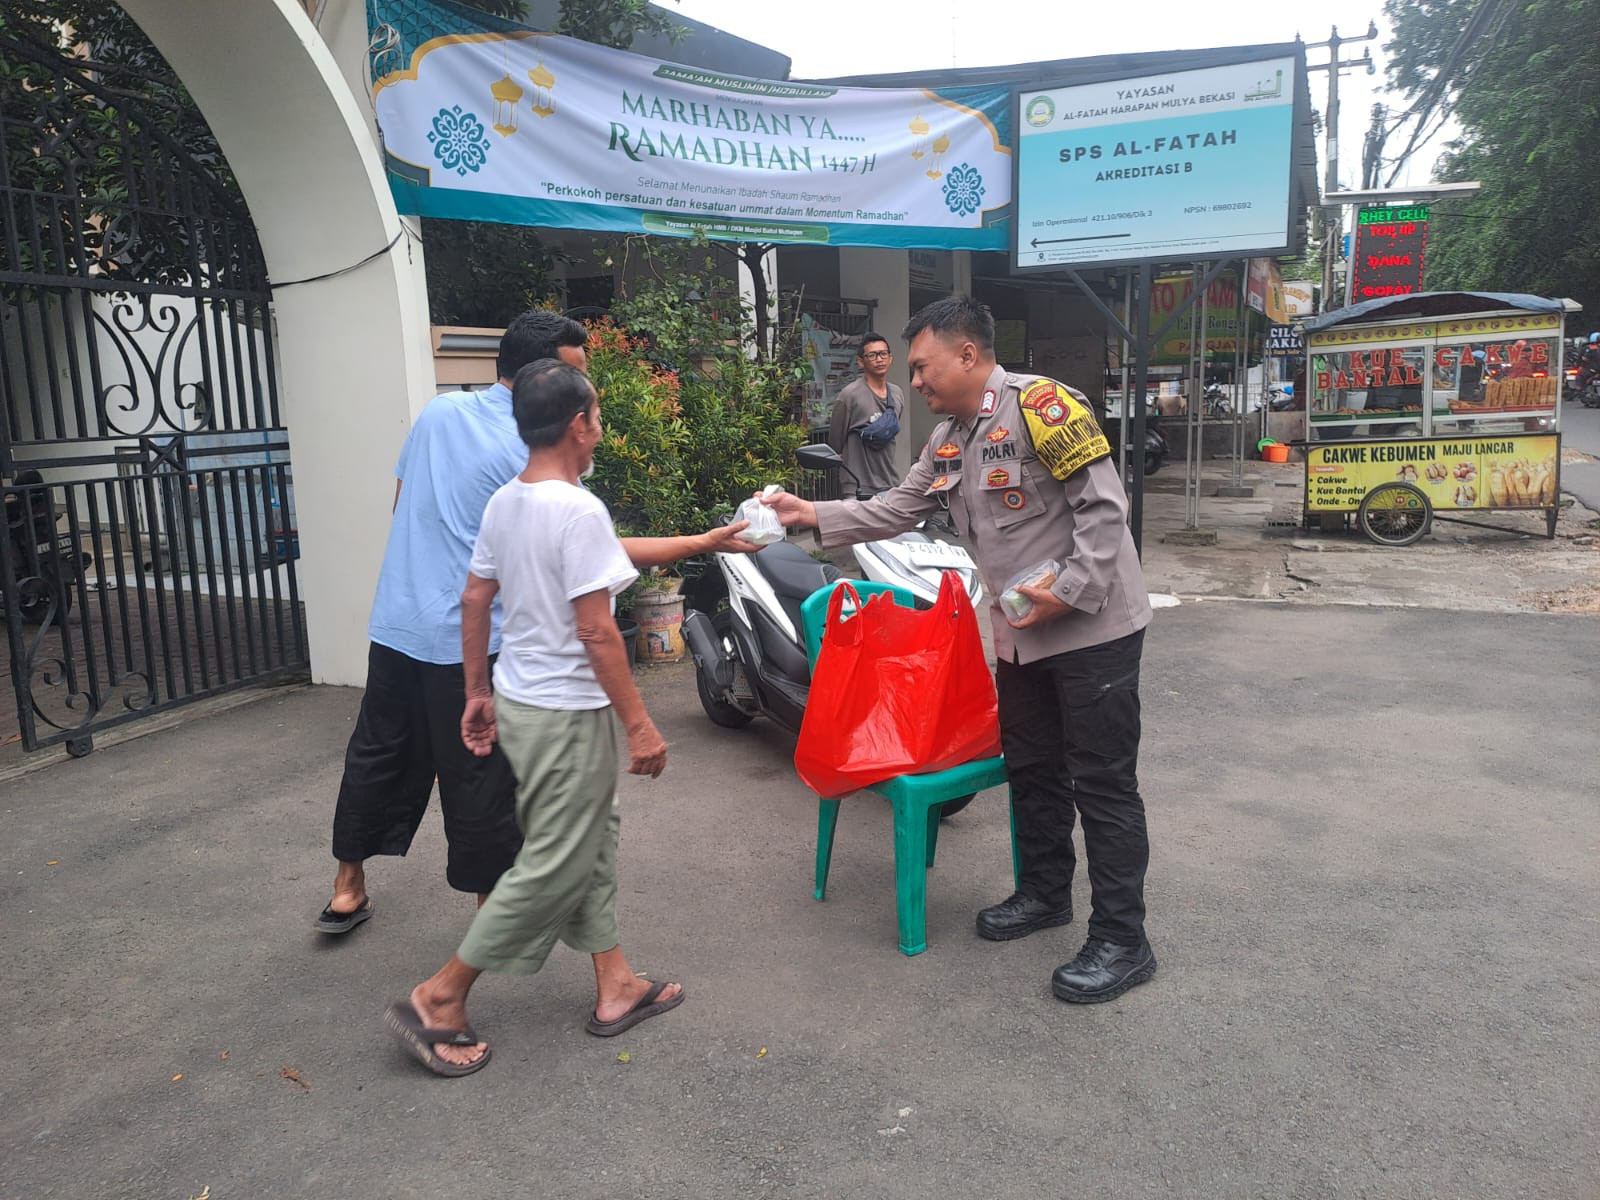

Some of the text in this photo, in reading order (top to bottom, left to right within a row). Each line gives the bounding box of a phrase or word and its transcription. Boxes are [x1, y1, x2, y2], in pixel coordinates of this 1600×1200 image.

[714, 78, 767, 92] MUSLIMIN
[1116, 84, 1176, 101] YAYASAN
[622, 89, 792, 136] MARHABAN
[1063, 91, 1236, 121] AL-FATAH HARAPAN MULYA BEKASI
[608, 121, 877, 175] RAMADHAN 1447 H
[1059, 129, 1238, 163] SPS AL-FATAH
[1095, 161, 1193, 182] AKREDITASI B
[638, 176, 841, 203] Selamat Menunaikan Ibadah Shaum Ramadhan
[605, 191, 663, 207] persatuan
[666, 197, 686, 209] dan
[689, 198, 737, 212] kesatuan
[739, 206, 773, 214] ummat
[775, 207, 803, 217] dalam
[805, 207, 853, 219] Momentum
[1184, 206, 1207, 215] NPSN
[1032, 220, 1045, 228] Izin
[1046, 216, 1088, 227] Operasional
[1370, 226, 1396, 238] TOP
[1367, 256, 1411, 268] DANA
[1361, 285, 1413, 297] GOPAY
[1350, 348, 1405, 369] KUE
[1436, 343, 1548, 367] CAKWE
[1317, 366, 1423, 390] BANTAL
[982, 443, 1017, 461] POLRI
[1323, 442, 1514, 464] CAKWE KEBUMEN MAJU LANCAR
[1316, 476, 1348, 484] Cakwe
[1316, 486, 1367, 495] Kue Bantal
[1316, 497, 1340, 506] Onde
